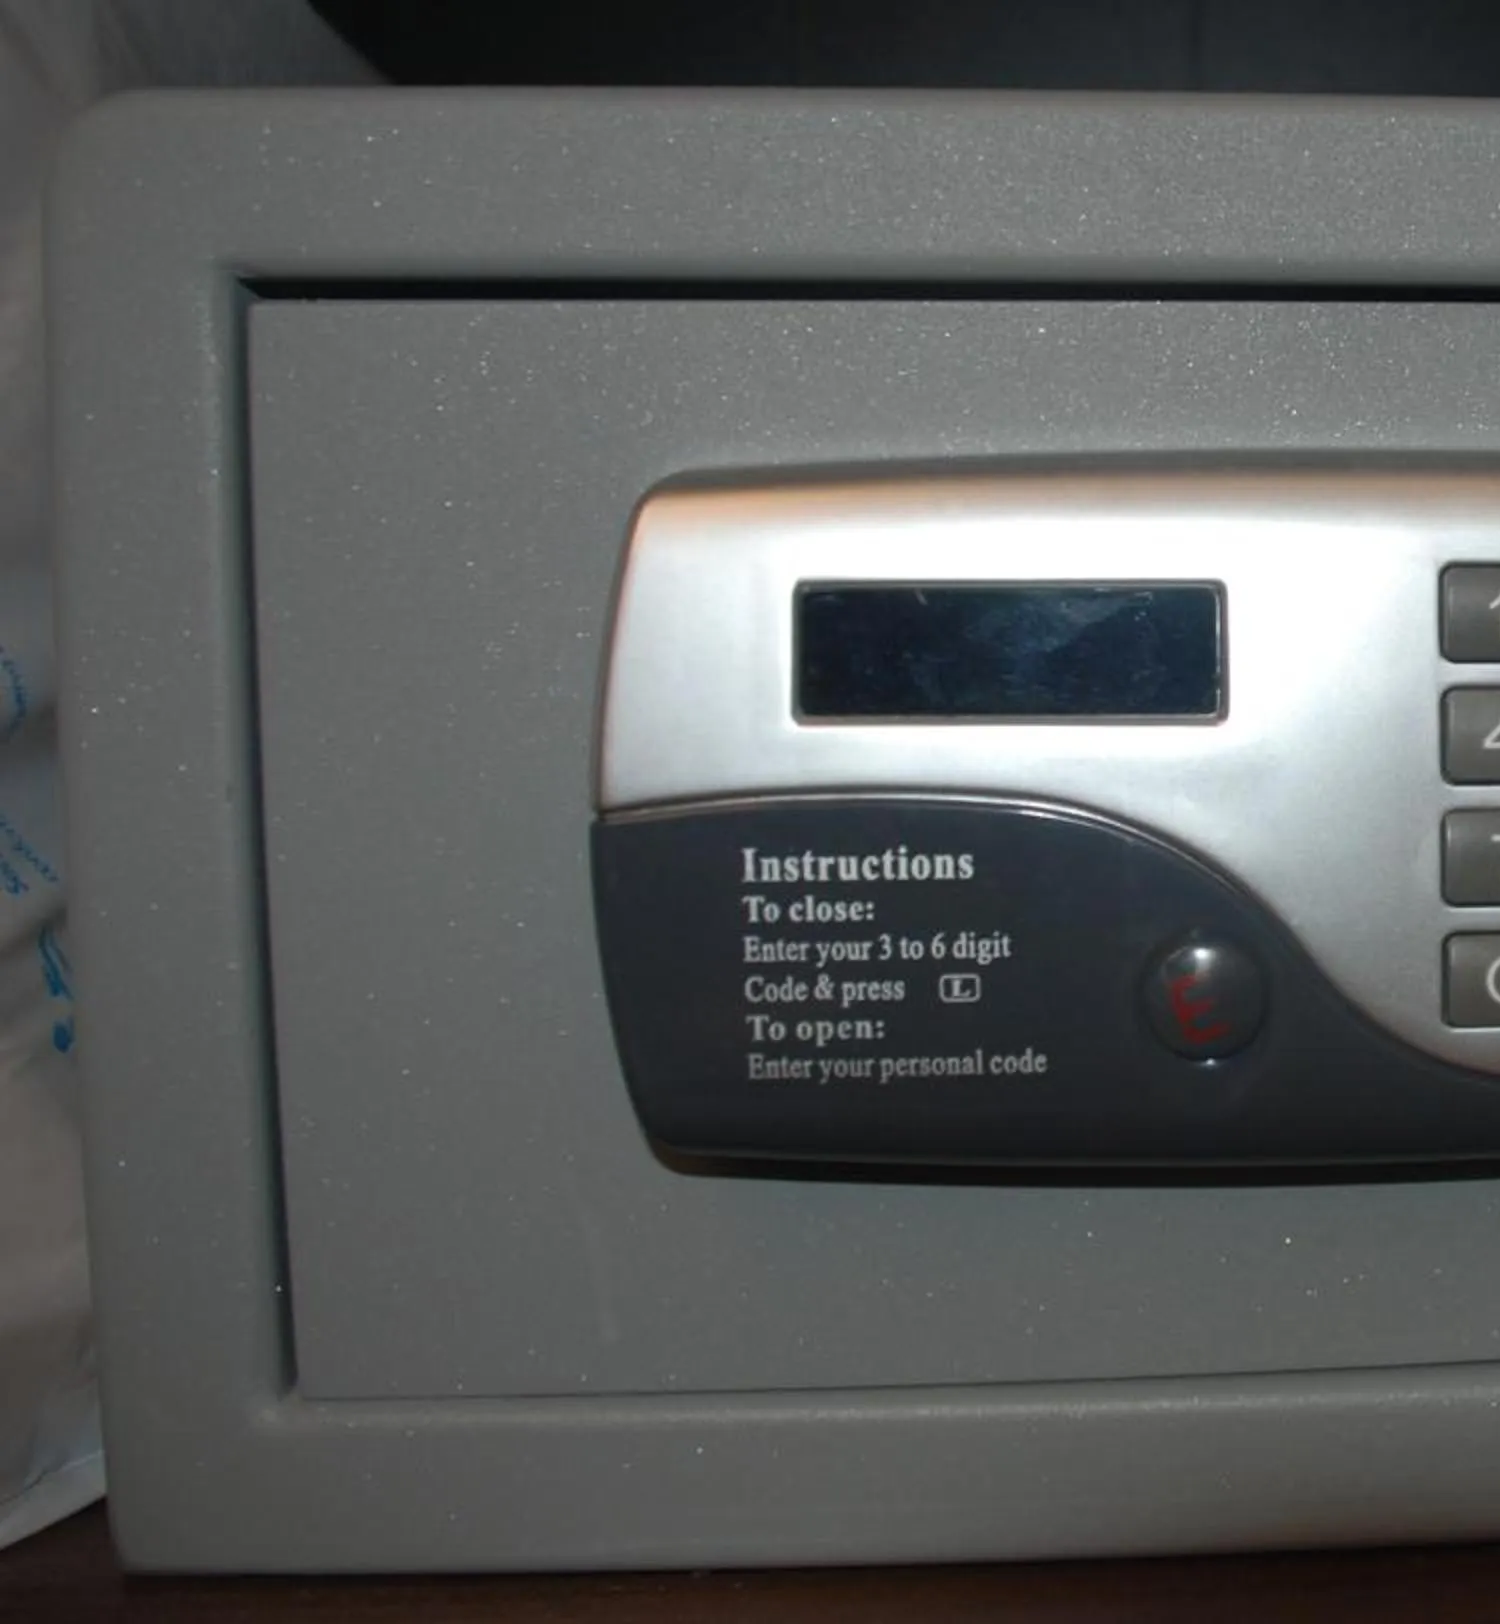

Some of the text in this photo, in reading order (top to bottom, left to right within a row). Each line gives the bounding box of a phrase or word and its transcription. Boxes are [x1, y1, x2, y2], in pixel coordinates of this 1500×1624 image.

[741, 847, 975, 884] Instructions
[742, 895, 876, 923] To close:
[743, 931, 1012, 968] Enter your 3 to 6 digit
[744, 975, 971, 1007] Code & press L
[746, 1016, 886, 1046] To open:
[748, 1048, 1048, 1083] Enter your personal code
